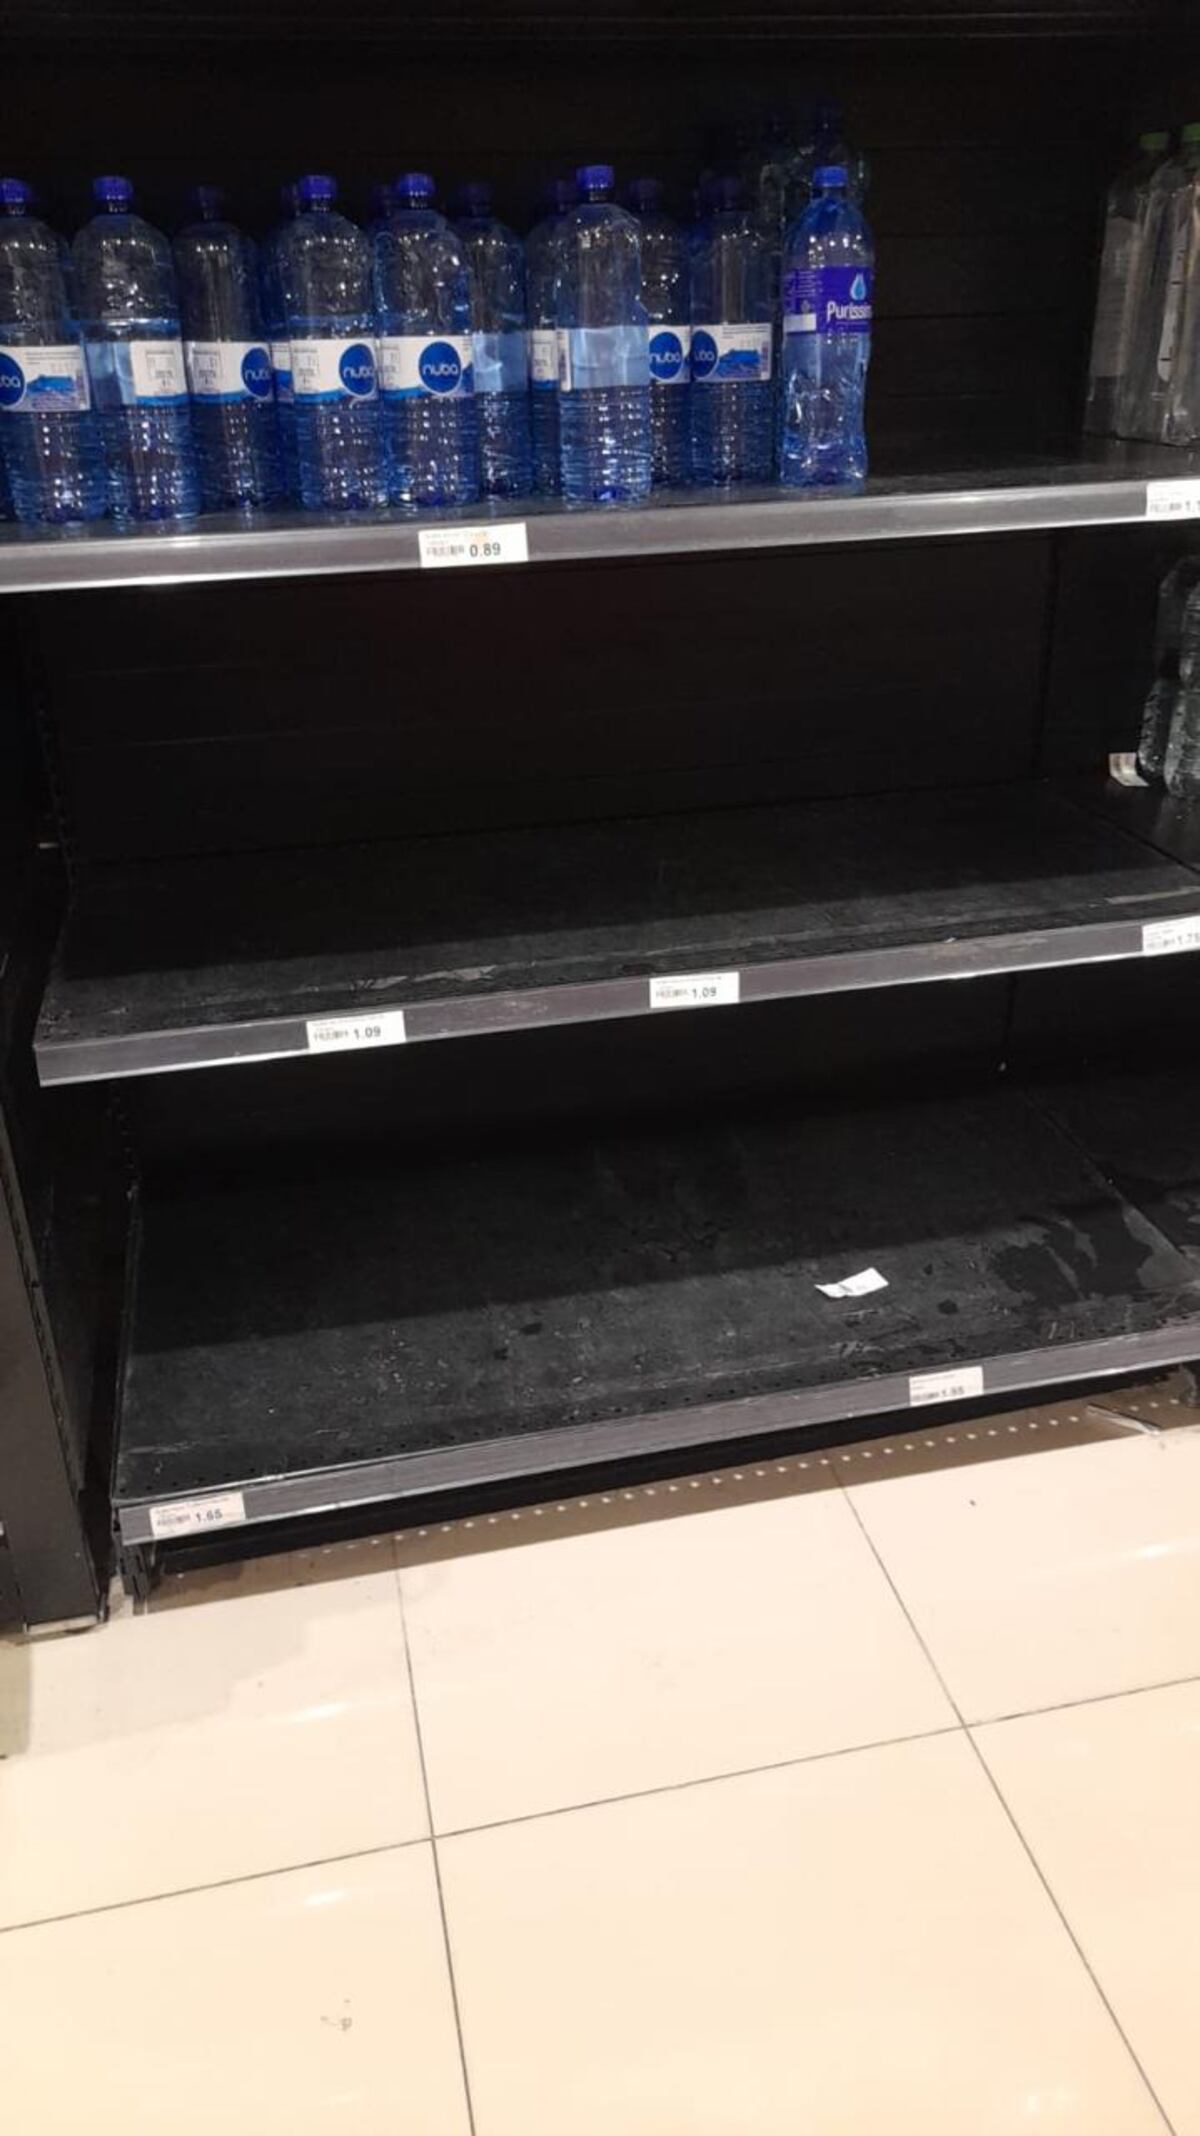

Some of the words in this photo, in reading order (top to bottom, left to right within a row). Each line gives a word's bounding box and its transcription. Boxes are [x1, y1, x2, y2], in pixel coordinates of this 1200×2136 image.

[469, 542, 501, 558] 0.89
[692, 986, 717, 1000] 1.09
[353, 1026, 382, 1041] 1.09
